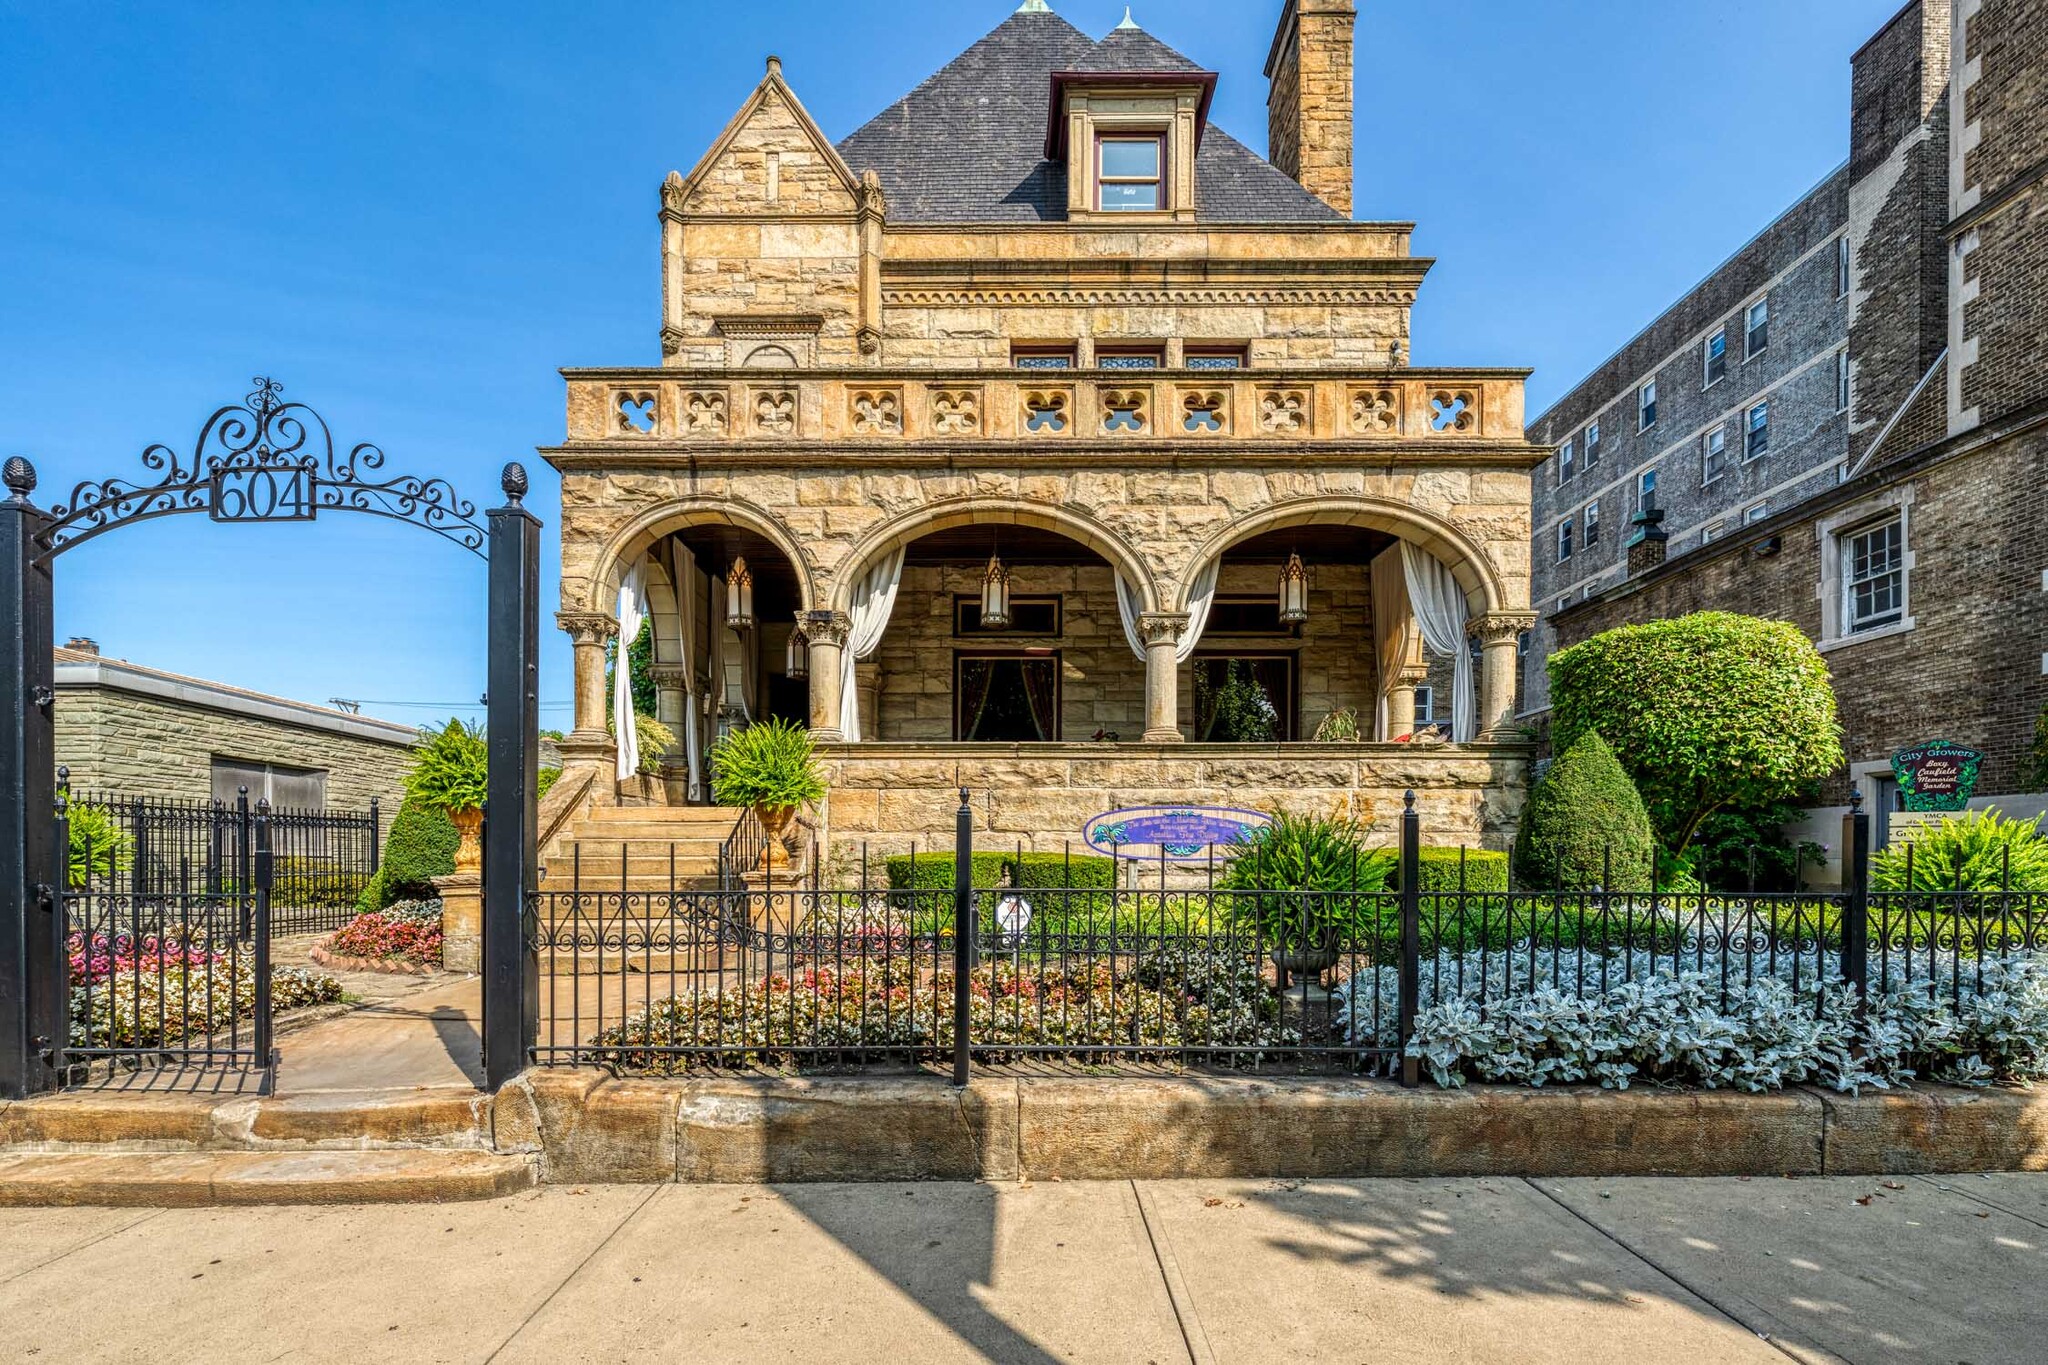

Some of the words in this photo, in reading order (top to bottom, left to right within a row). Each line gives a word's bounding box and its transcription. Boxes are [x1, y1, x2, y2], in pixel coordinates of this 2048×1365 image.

[216, 468, 311, 518] 604
[1900, 751, 1923, 762] City
[1926, 749, 1975, 758] Growers
